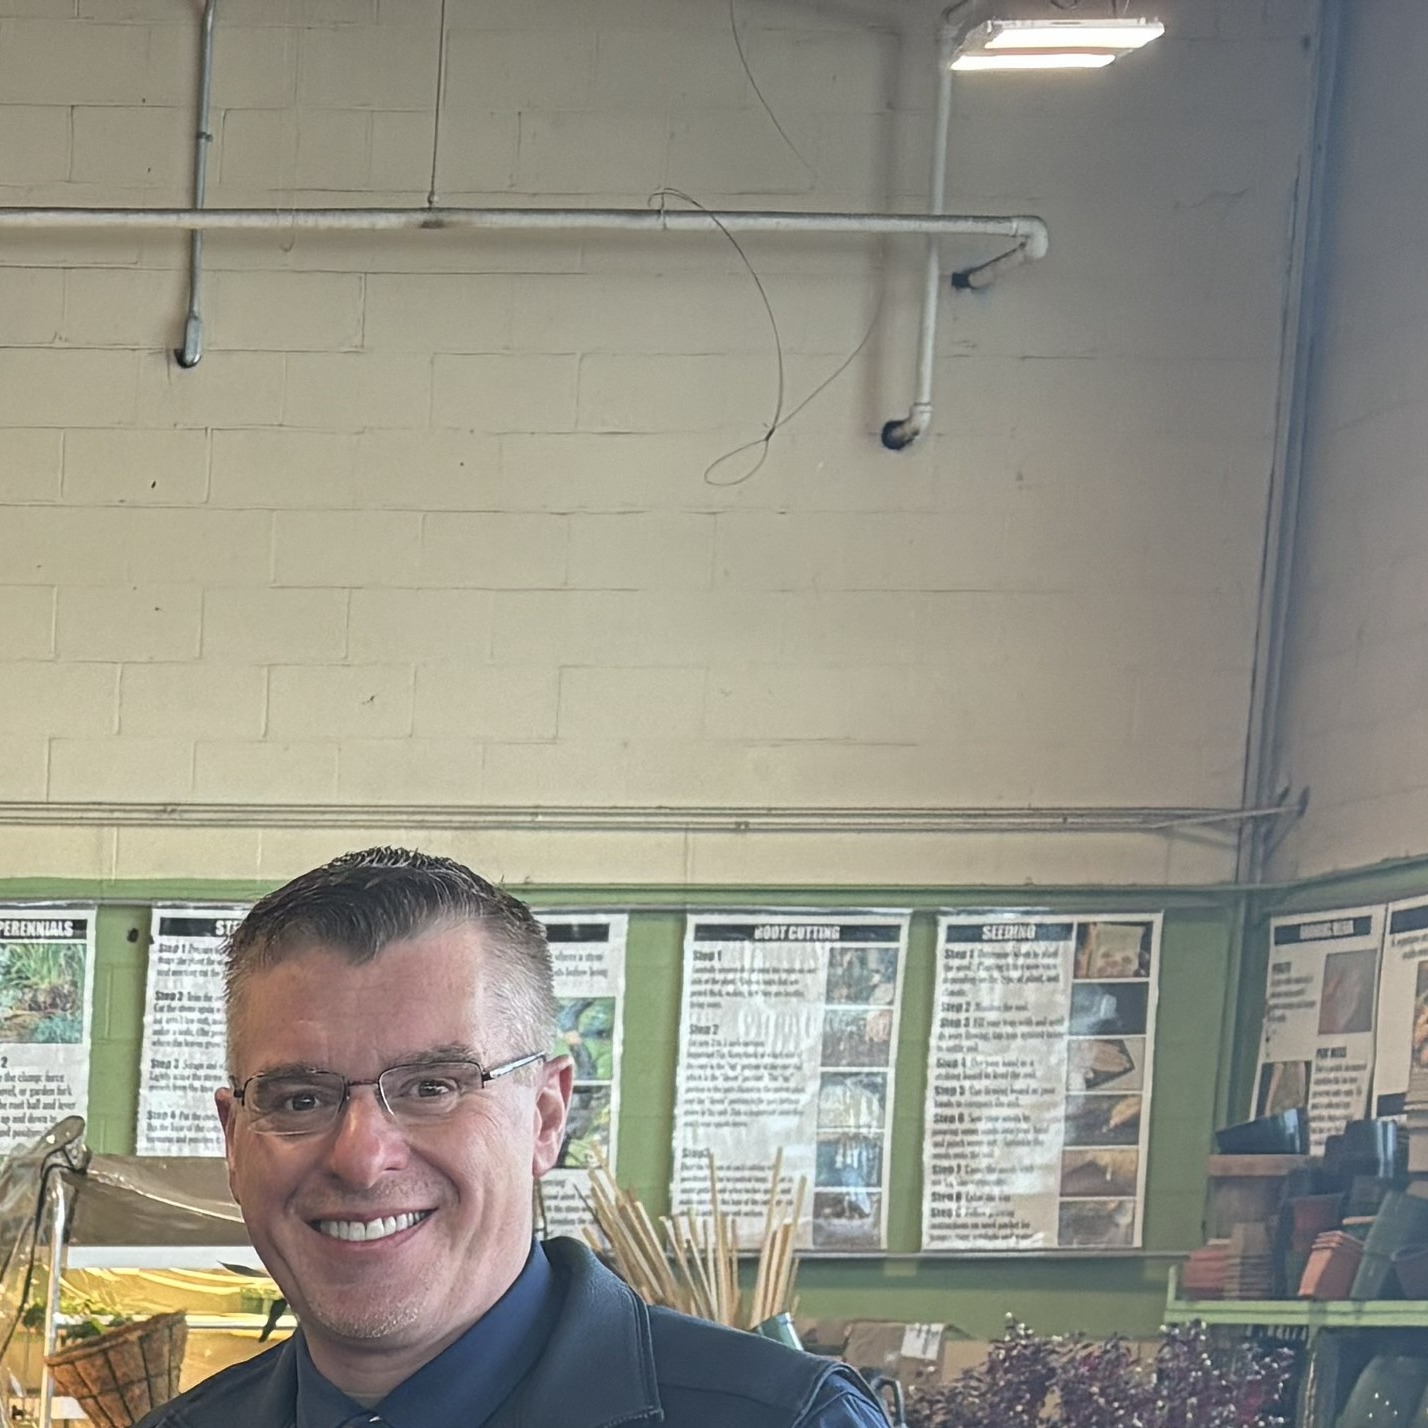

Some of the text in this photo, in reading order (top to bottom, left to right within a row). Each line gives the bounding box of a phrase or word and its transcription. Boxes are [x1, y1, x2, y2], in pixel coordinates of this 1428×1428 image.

[754, 926, 841, 940] ROOT CUTTING
[982, 924, 1036, 940] SEEDING
[1, 1056, 8, 1069] 2
